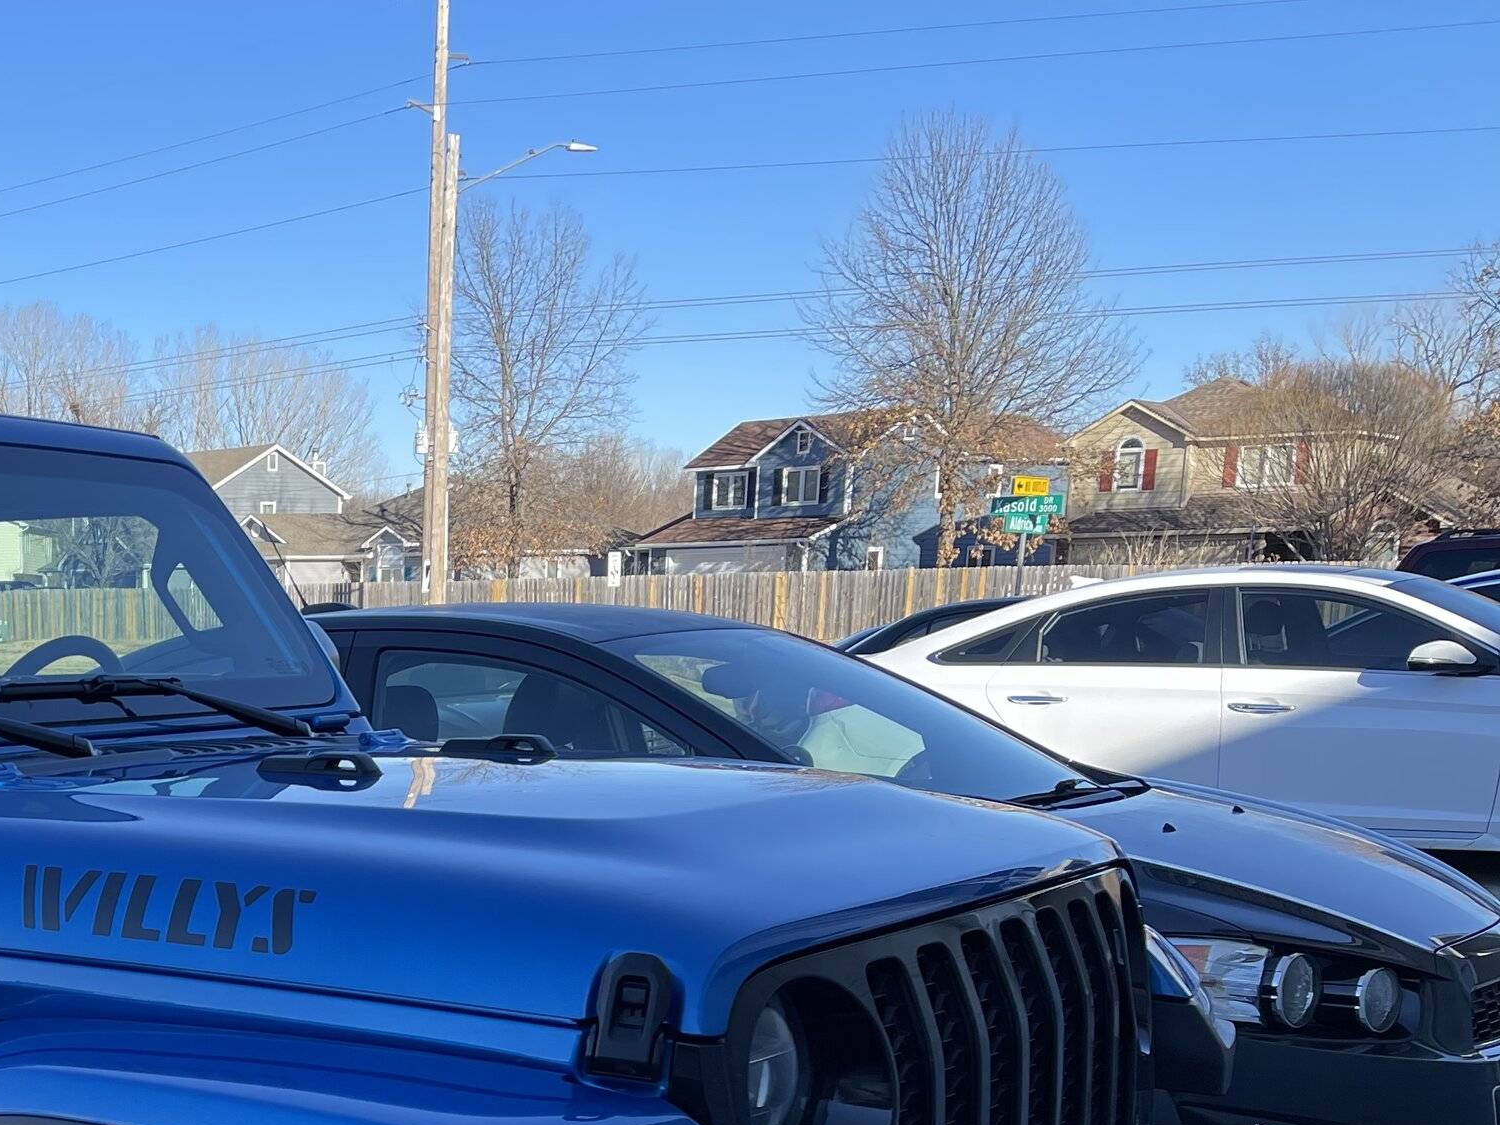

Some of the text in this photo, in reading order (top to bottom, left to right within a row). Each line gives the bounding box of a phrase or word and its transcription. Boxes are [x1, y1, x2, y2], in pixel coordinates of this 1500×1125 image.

[1043, 496, 1054, 504] DR
[1039, 504, 1058, 513] 3000
[23, 864, 317, 955] WILLYS
